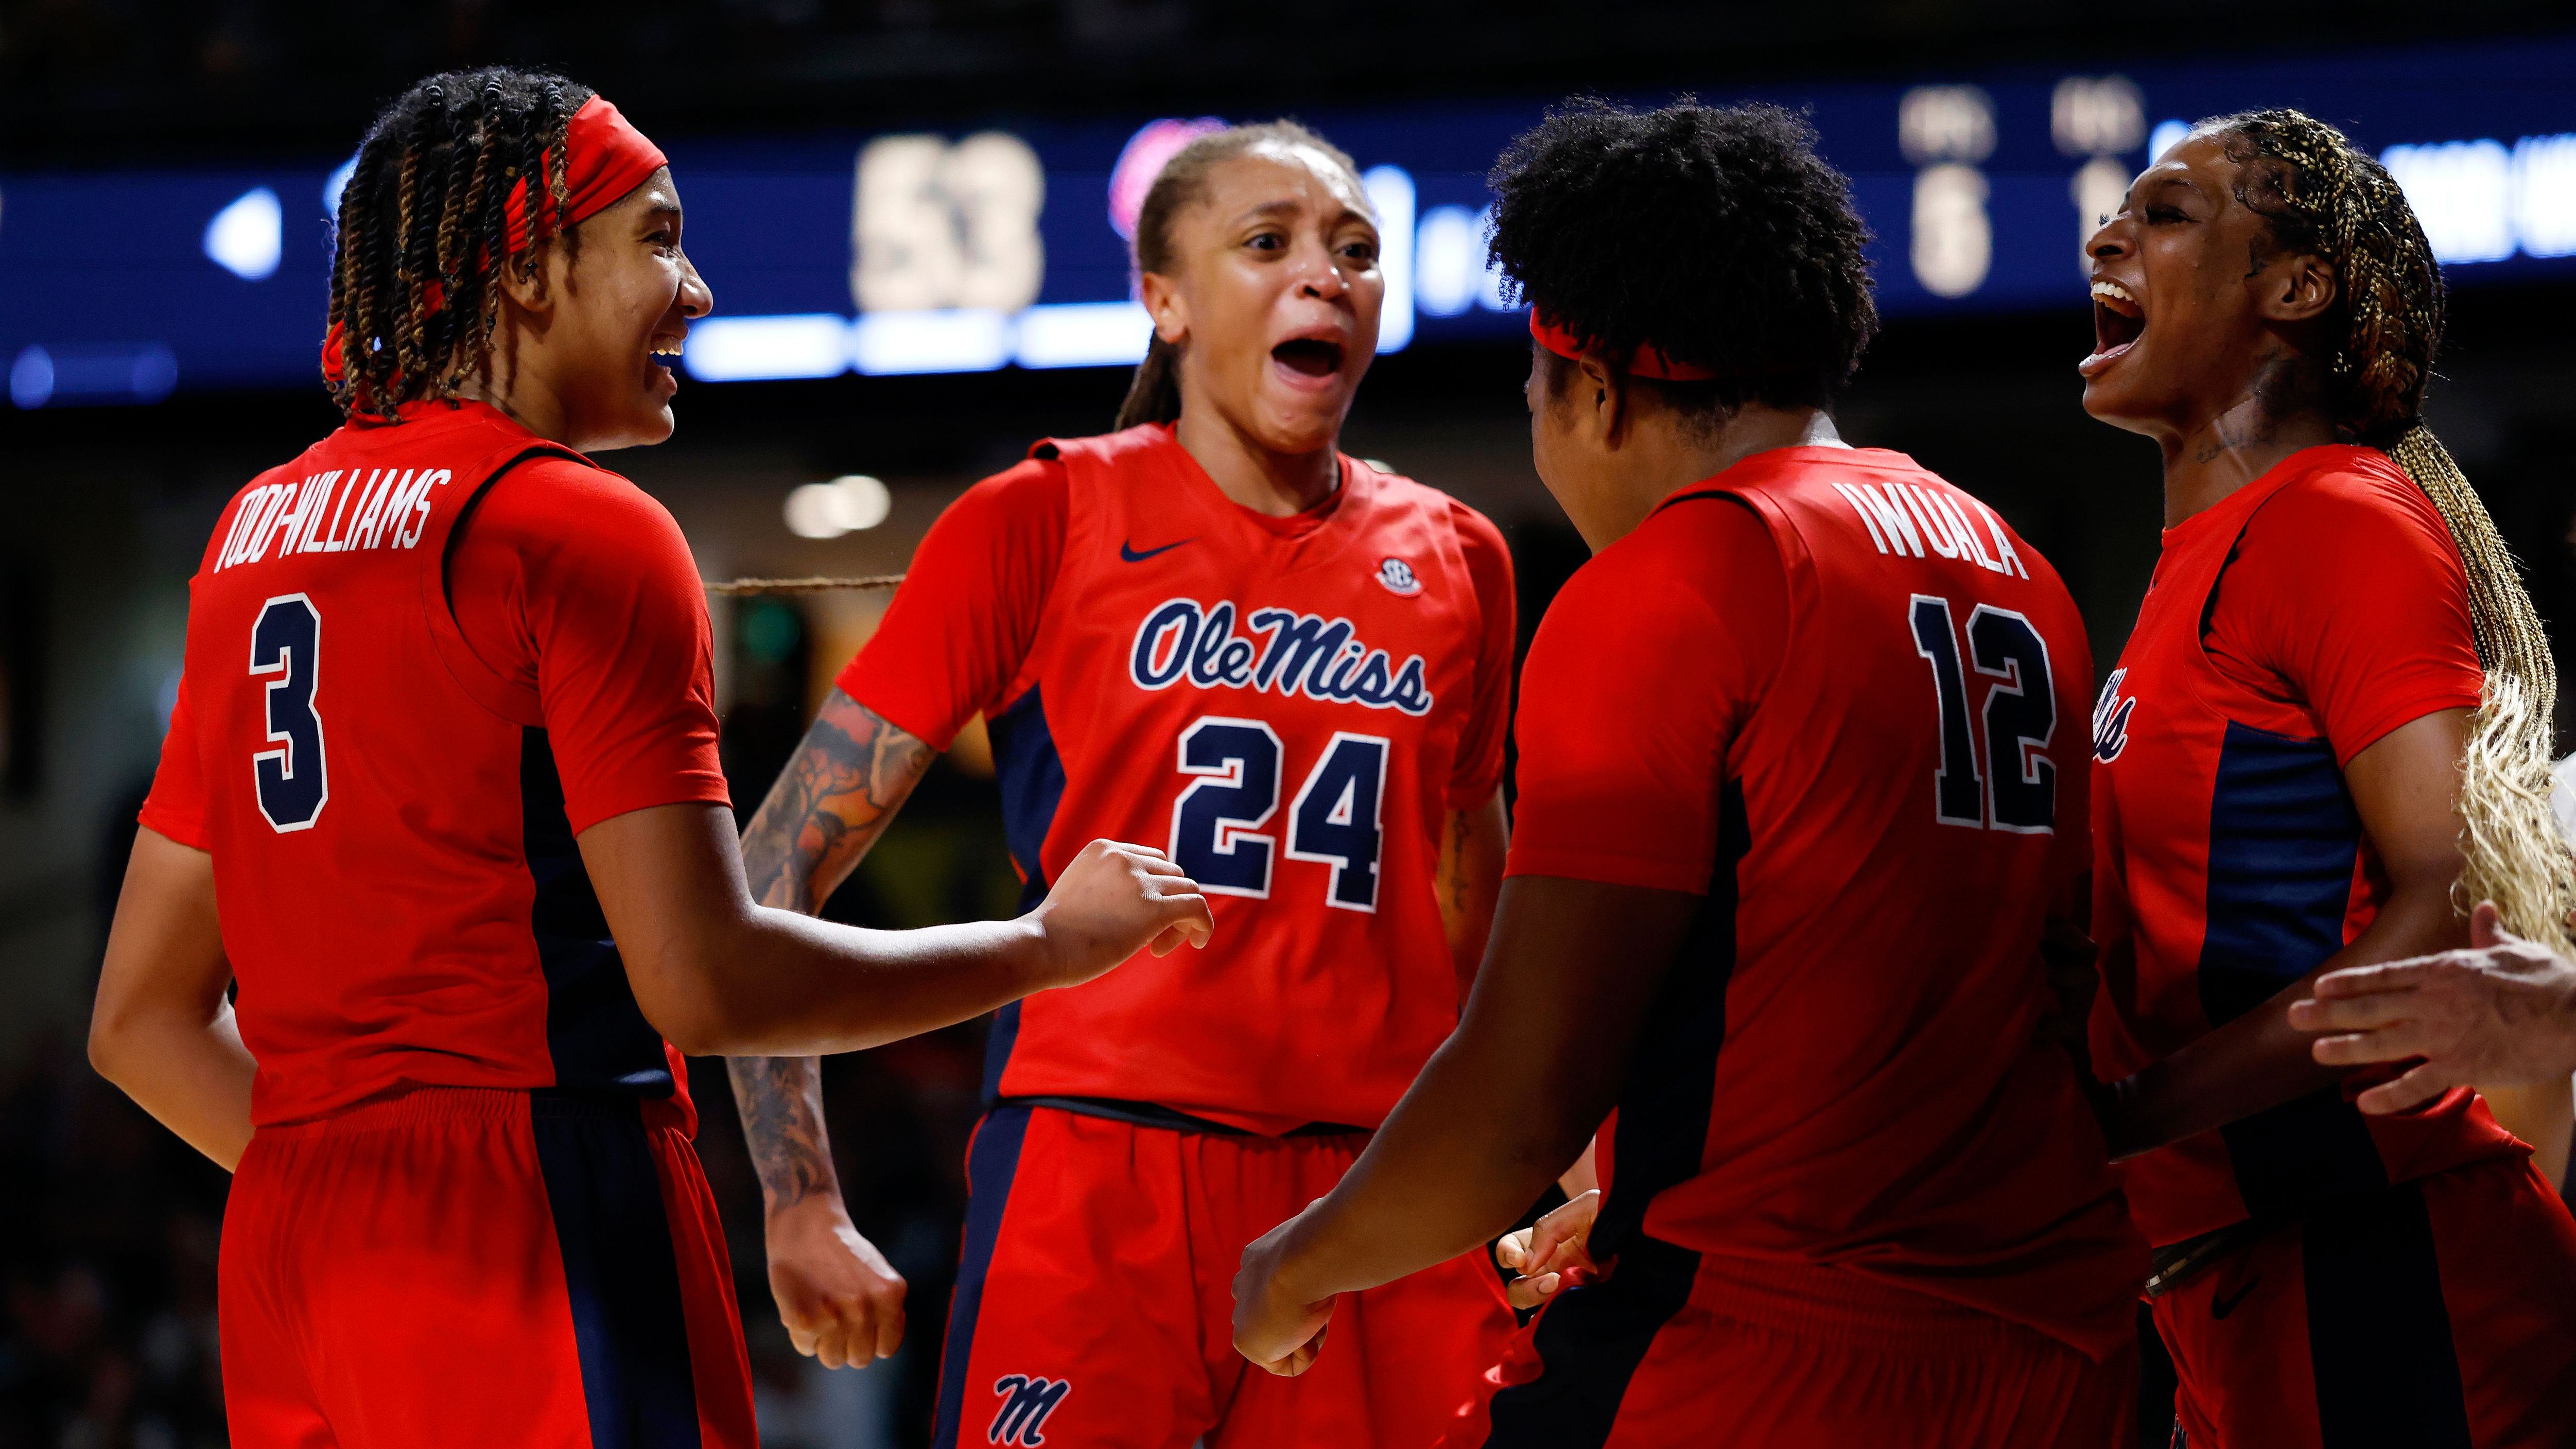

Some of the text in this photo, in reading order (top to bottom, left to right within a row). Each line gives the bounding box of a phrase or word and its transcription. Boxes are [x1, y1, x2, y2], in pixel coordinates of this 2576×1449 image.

[214, 468, 452, 573] TODD-WILLIAMS
[1832, 482, 2029, 580] IWUALA
[249, 592, 329, 834] 3
[1130, 598, 1434, 717] Ole Miss
[1908, 593, 2057, 836] 12
[1167, 715, 1390, 914] 24
[987, 1373, 1071, 1448] M
